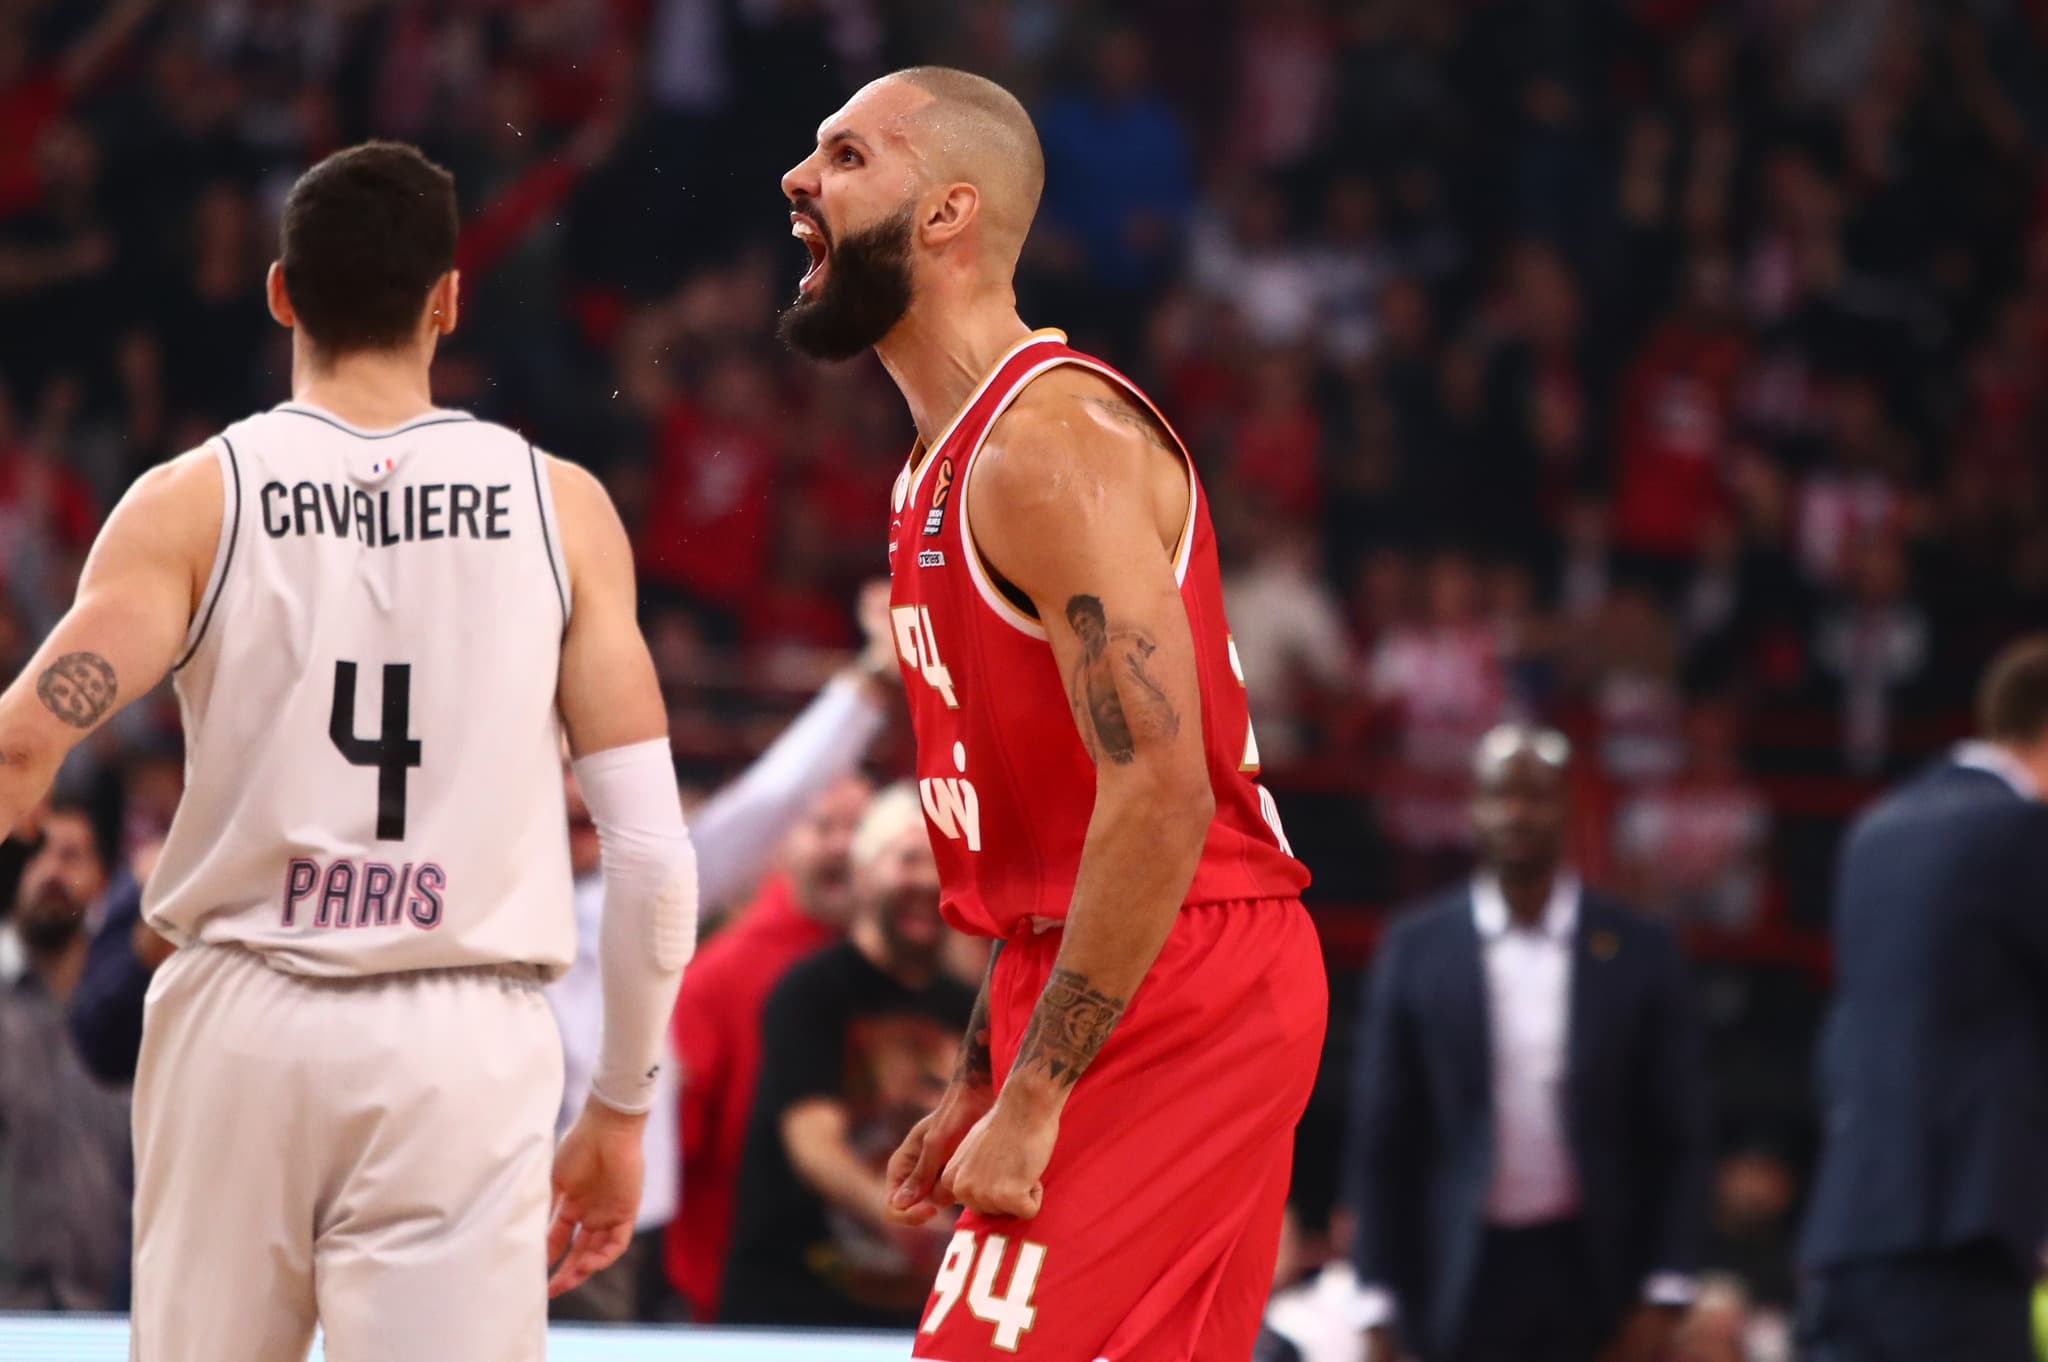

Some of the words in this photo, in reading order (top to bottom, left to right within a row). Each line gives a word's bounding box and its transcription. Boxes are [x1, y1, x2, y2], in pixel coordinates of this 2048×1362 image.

[260, 481, 511, 548] CAVALIERE
[329, 660, 422, 841] 4
[281, 857, 446, 930] PARIS
[920, 1229, 1048, 1353] 94
